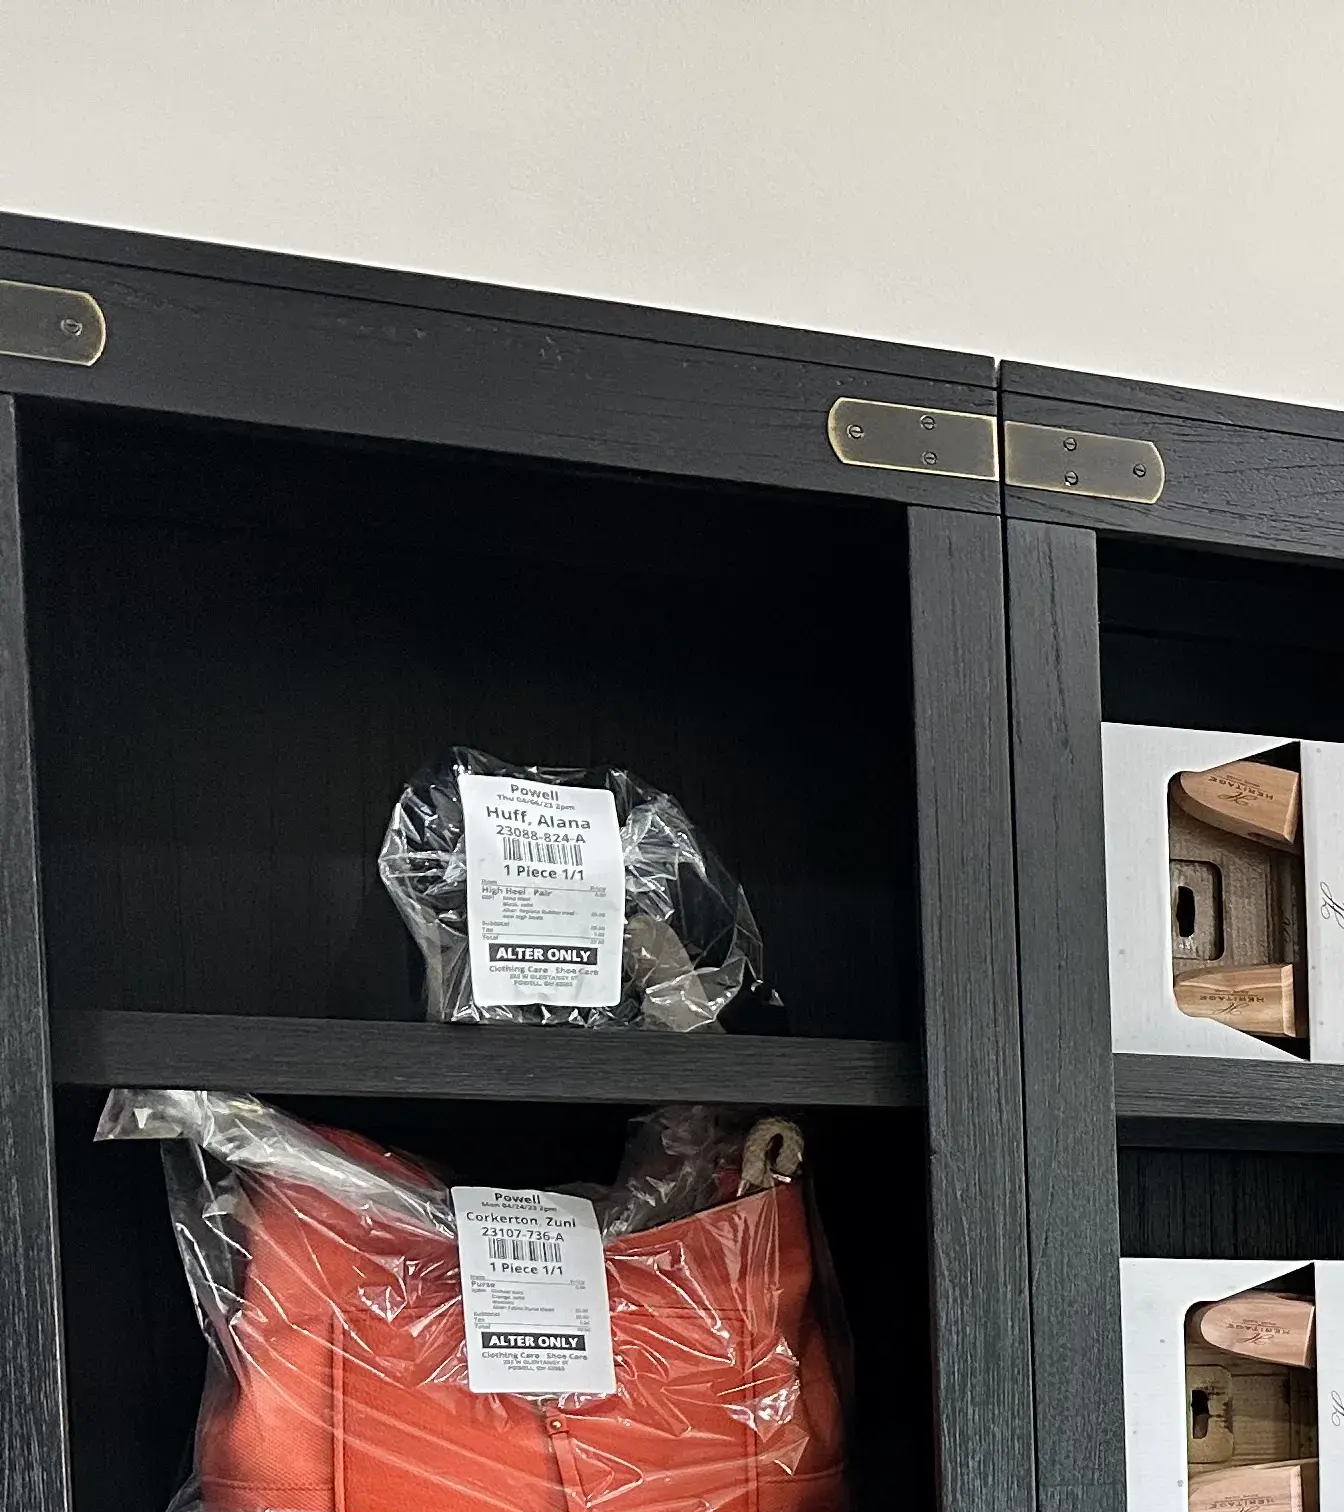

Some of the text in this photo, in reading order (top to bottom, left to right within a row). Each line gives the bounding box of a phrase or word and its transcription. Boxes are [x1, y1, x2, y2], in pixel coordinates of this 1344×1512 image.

[510, 783, 559, 801] Powell
[486, 806, 591, 829] Huff, Alana
[496, 825, 586, 843] 23088-824-A
[504, 865, 583, 880] 1 Piece 1/1
[496, 948, 591, 962] ALTER ONLY
[489, 965, 525, 974] Clothing
[495, 1192, 541, 1204] Powell
[482, 1226, 565, 1242] 23107-736-A
[490, 1262, 563, 1275] 1 Piece 1/1
[489, 1335, 579, 1348] ALTER ONLY
[482, 1352, 518, 1360] Clothing
